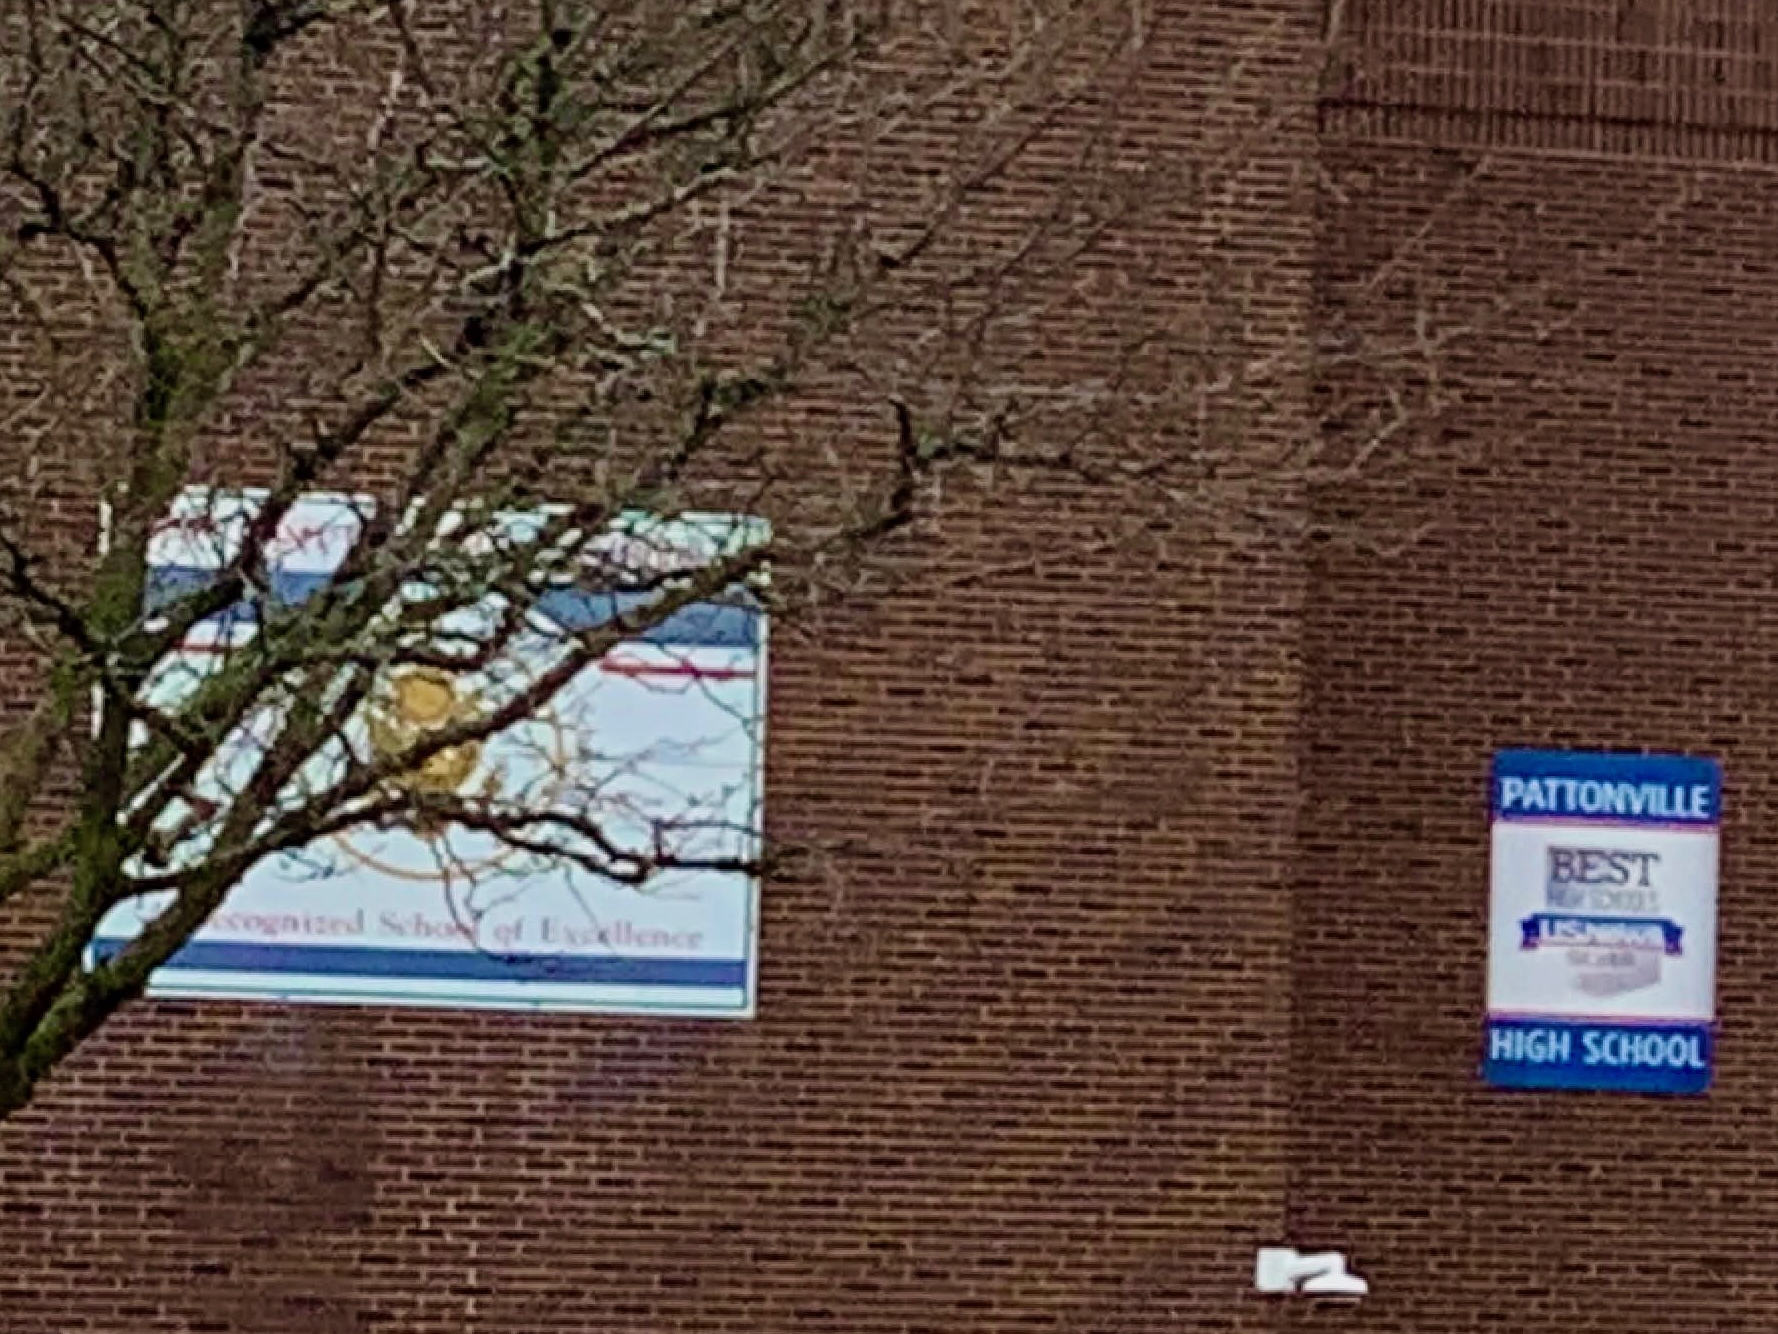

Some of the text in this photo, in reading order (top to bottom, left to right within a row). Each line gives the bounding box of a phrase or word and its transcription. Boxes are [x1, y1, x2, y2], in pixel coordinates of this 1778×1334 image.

[1500, 776, 1710, 818] PATTONVILLE
[1549, 846, 1661, 887] BEST
[207, 908, 704, 948] ecognized School of Excellence
[1491, 1027, 1706, 1068] HIGH SCHOOL
